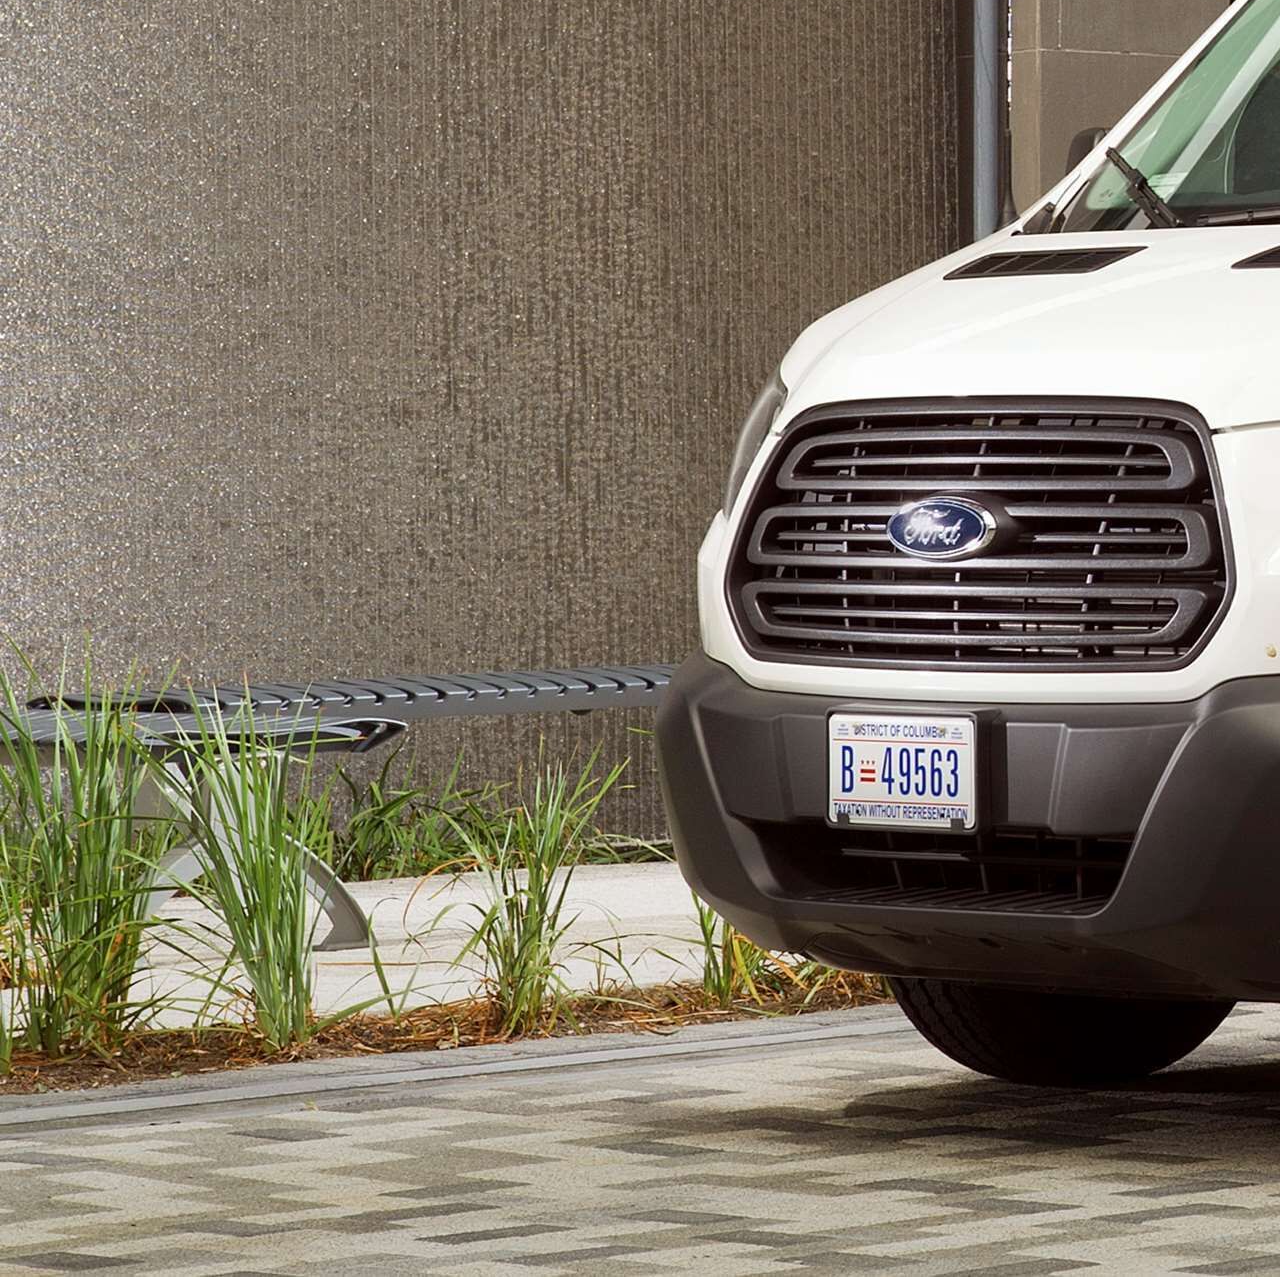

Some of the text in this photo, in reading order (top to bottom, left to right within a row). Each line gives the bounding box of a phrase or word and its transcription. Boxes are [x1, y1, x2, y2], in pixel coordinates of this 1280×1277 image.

[903, 507, 965, 546] Ford
[854, 723, 888, 736] DISTRICT
[890, 725, 900, 737] OF
[841, 745, 959, 798] B 49563
[833, 802, 968, 821] TAXATION WITHOUT REPRESENTATION
